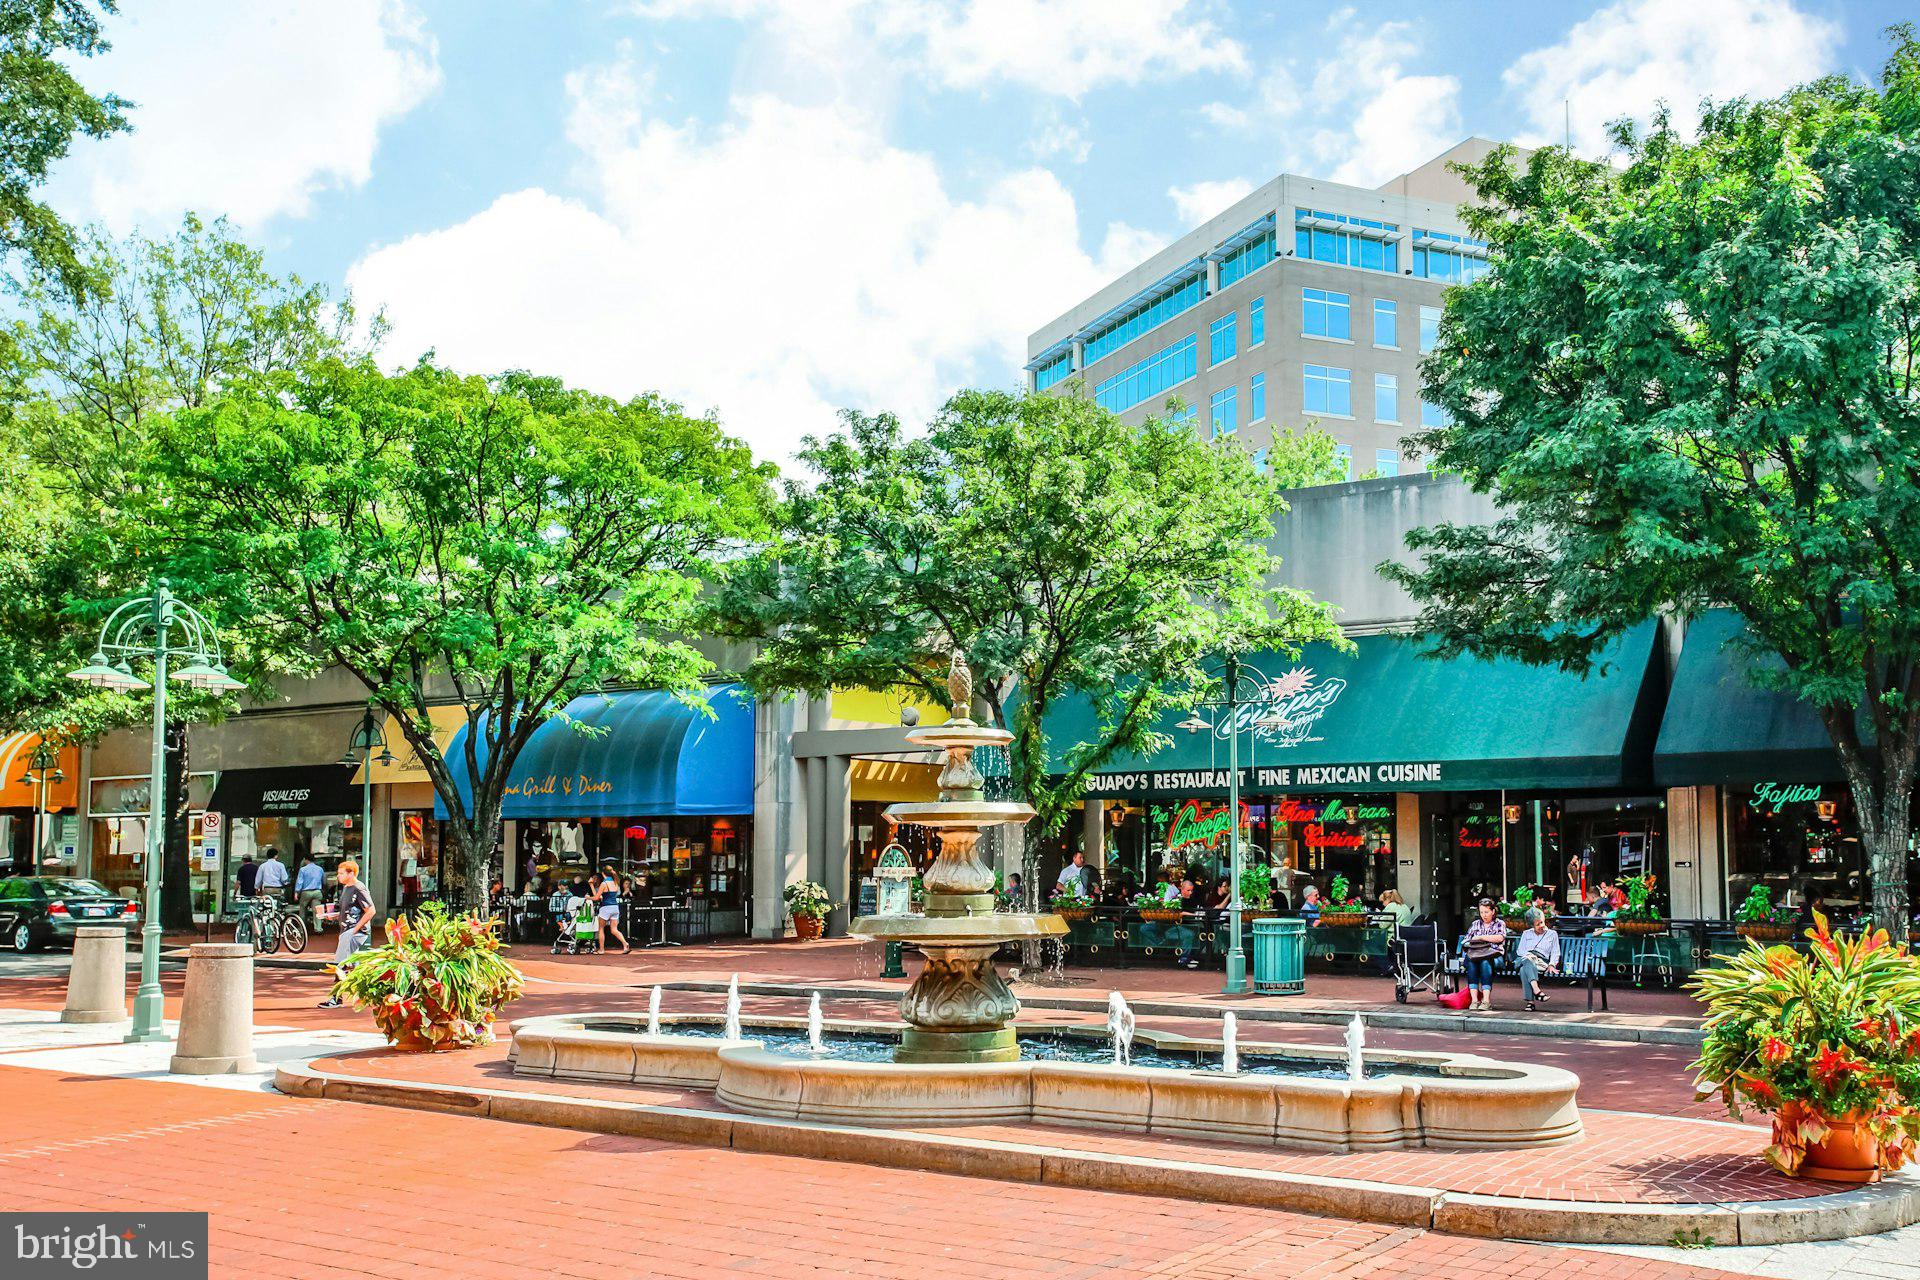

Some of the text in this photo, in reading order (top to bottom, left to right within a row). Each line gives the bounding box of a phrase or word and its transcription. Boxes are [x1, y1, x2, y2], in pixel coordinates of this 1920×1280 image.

[523, 775, 557, 799] Grill
[579, 774, 614, 796] Diner
[1085, 774, 1149, 791] GUAPO'S
[1258, 769, 1290, 787] FINE
[1297, 766, 1371, 785] MEXICAN
[1377, 763, 1442, 782] CUISINE
[262, 788, 311, 802] VISUALEYES
[1749, 782, 1822, 813] Fajitas
[1317, 799, 1388, 822] Mecan
